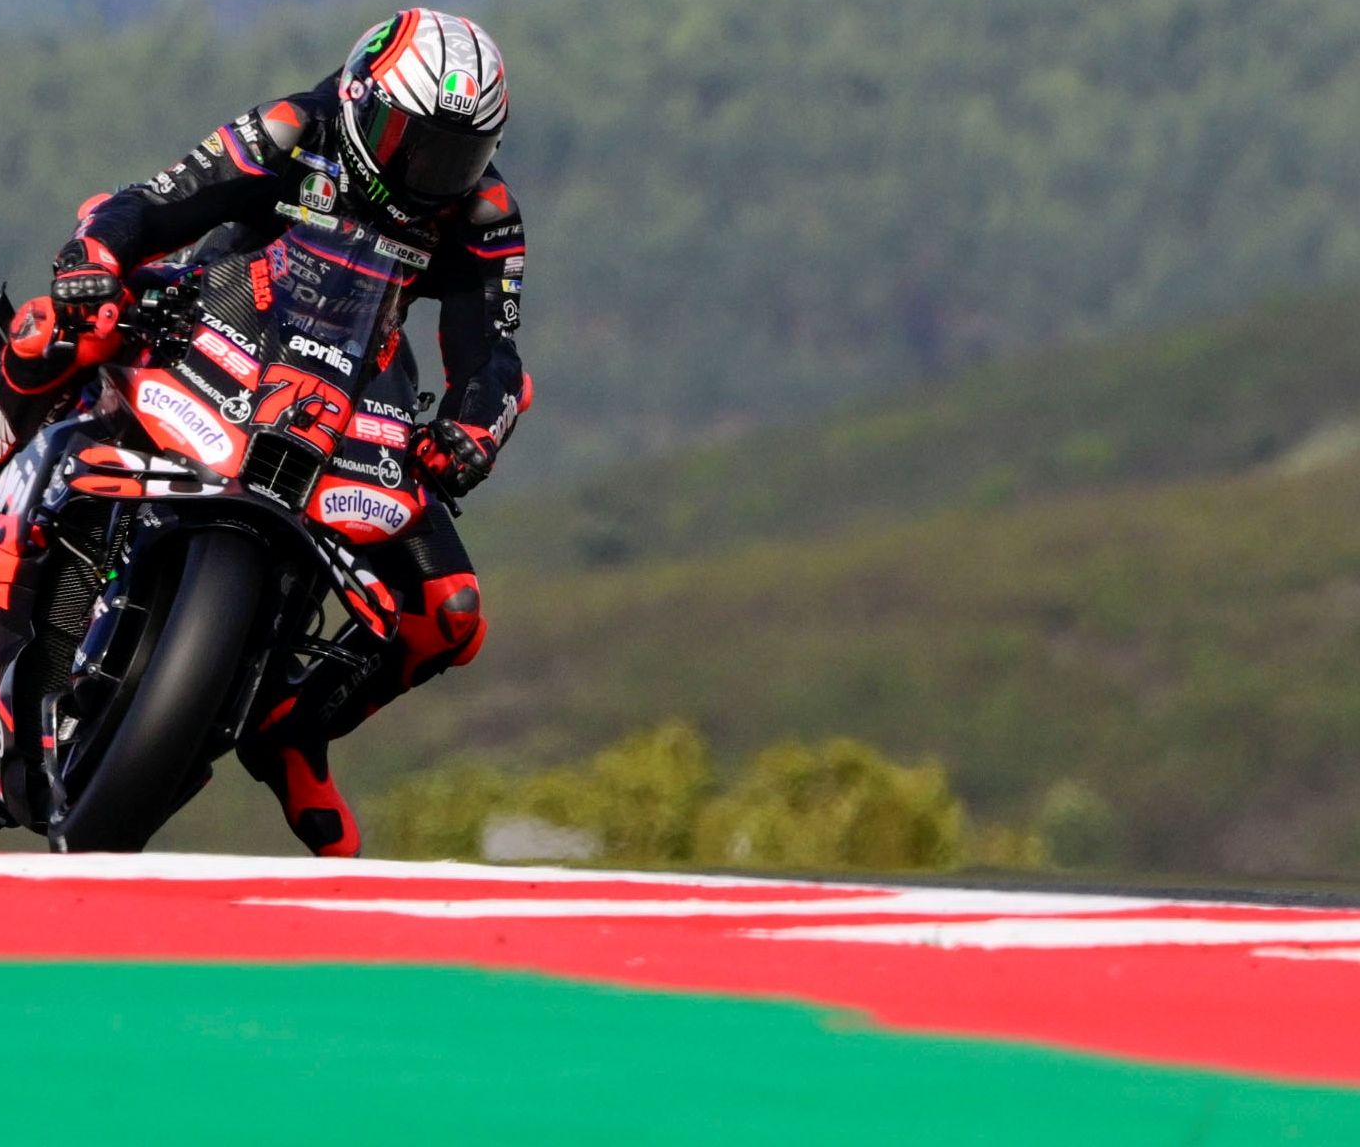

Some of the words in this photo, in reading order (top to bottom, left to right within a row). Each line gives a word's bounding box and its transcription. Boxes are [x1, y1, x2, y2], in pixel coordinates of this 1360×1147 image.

[199, 312, 258, 357] TARGA
[288, 334, 353, 377] aprilia
[177, 362, 226, 405] PRAGMATIC
[224, 400, 249, 420] PLAY
[249, 362, 354, 461] 72
[363, 398, 414, 425] TARGA
[355, 417, 406, 443] BS
[333, 456, 380, 477] PRAGMATIC
[380, 467, 400, 481] PLAY
[324, 489, 405, 529] sterilgarda
